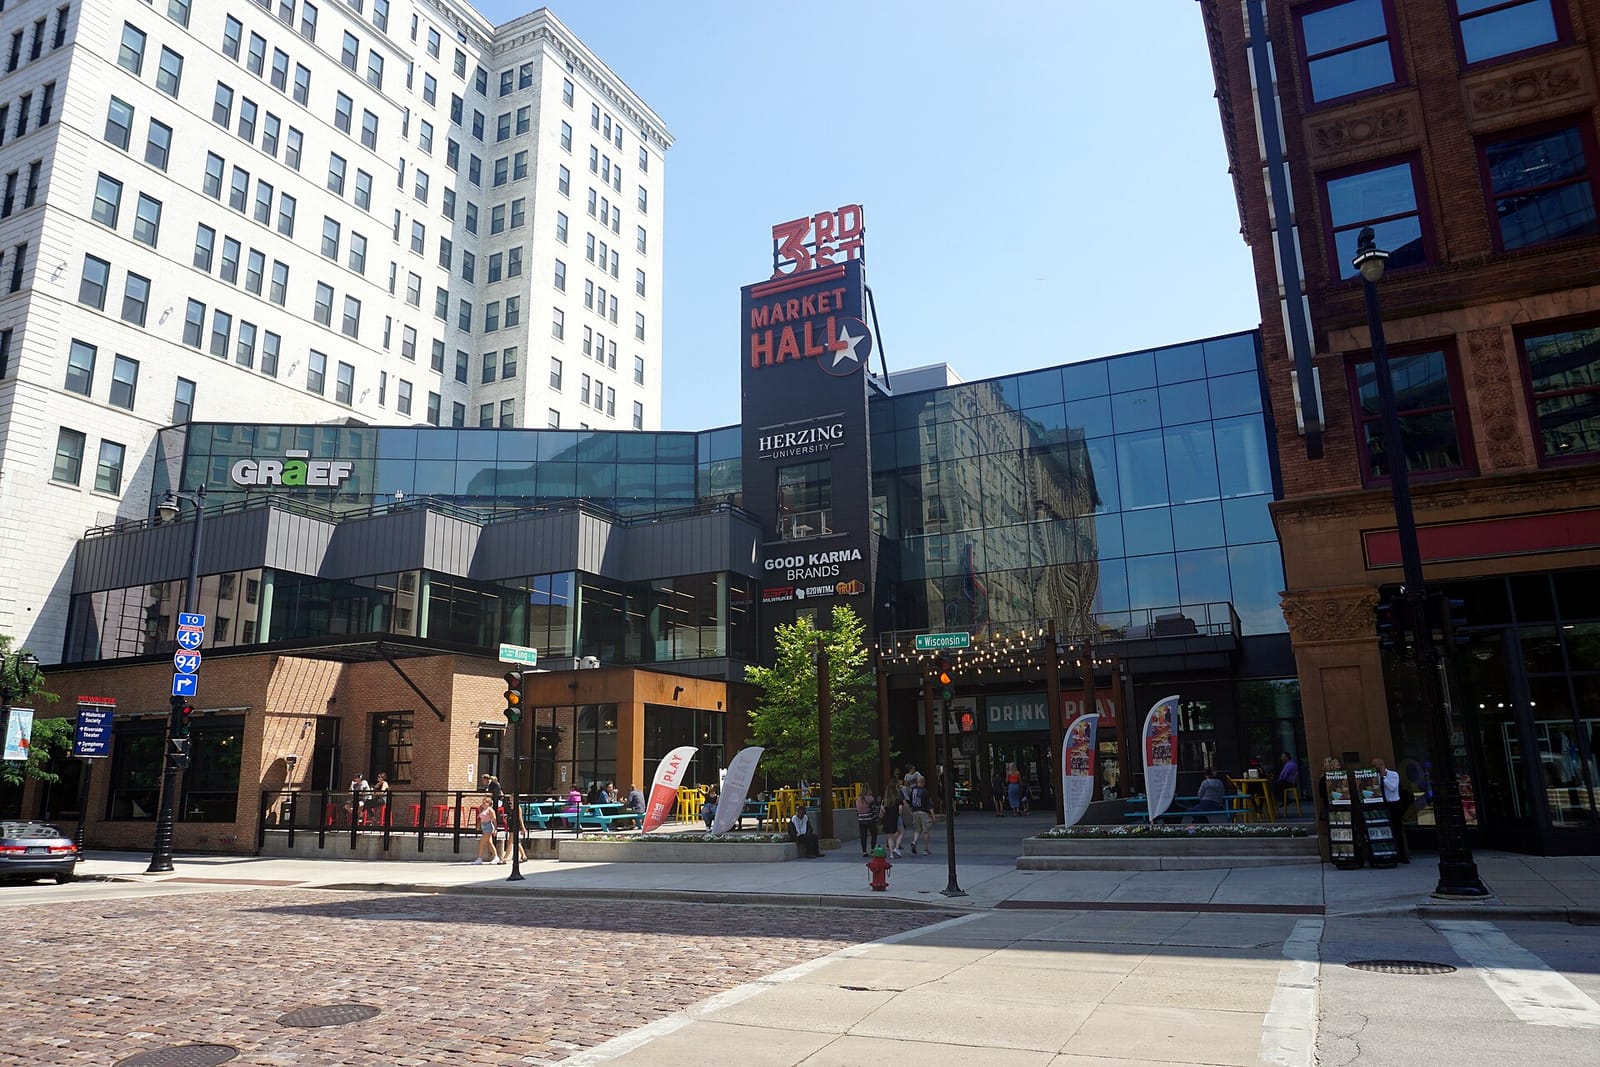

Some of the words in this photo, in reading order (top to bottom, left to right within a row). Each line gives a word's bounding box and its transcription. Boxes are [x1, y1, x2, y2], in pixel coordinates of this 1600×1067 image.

[751, 287, 847, 329] MARKET
[751, 316, 848, 368] HALL
[759, 423, 844, 452] HERZING
[772, 443, 831, 459] UNIVERSITY
[764, 555, 805, 571] GOOD
[808, 548, 863, 566] KARMA
[787, 564, 840, 581] BRANDS
[186, 615, 199, 624] TO
[180, 631, 200, 646] 43
[924, 636, 960, 647] Wisconsin
[176, 655, 197, 670] 94
[78, 695, 116, 704] MILWAUKEE
[990, 703, 1046, 722] DRINK
[85, 717, 102, 725] Society
[663, 754, 682, 783] PLAY
